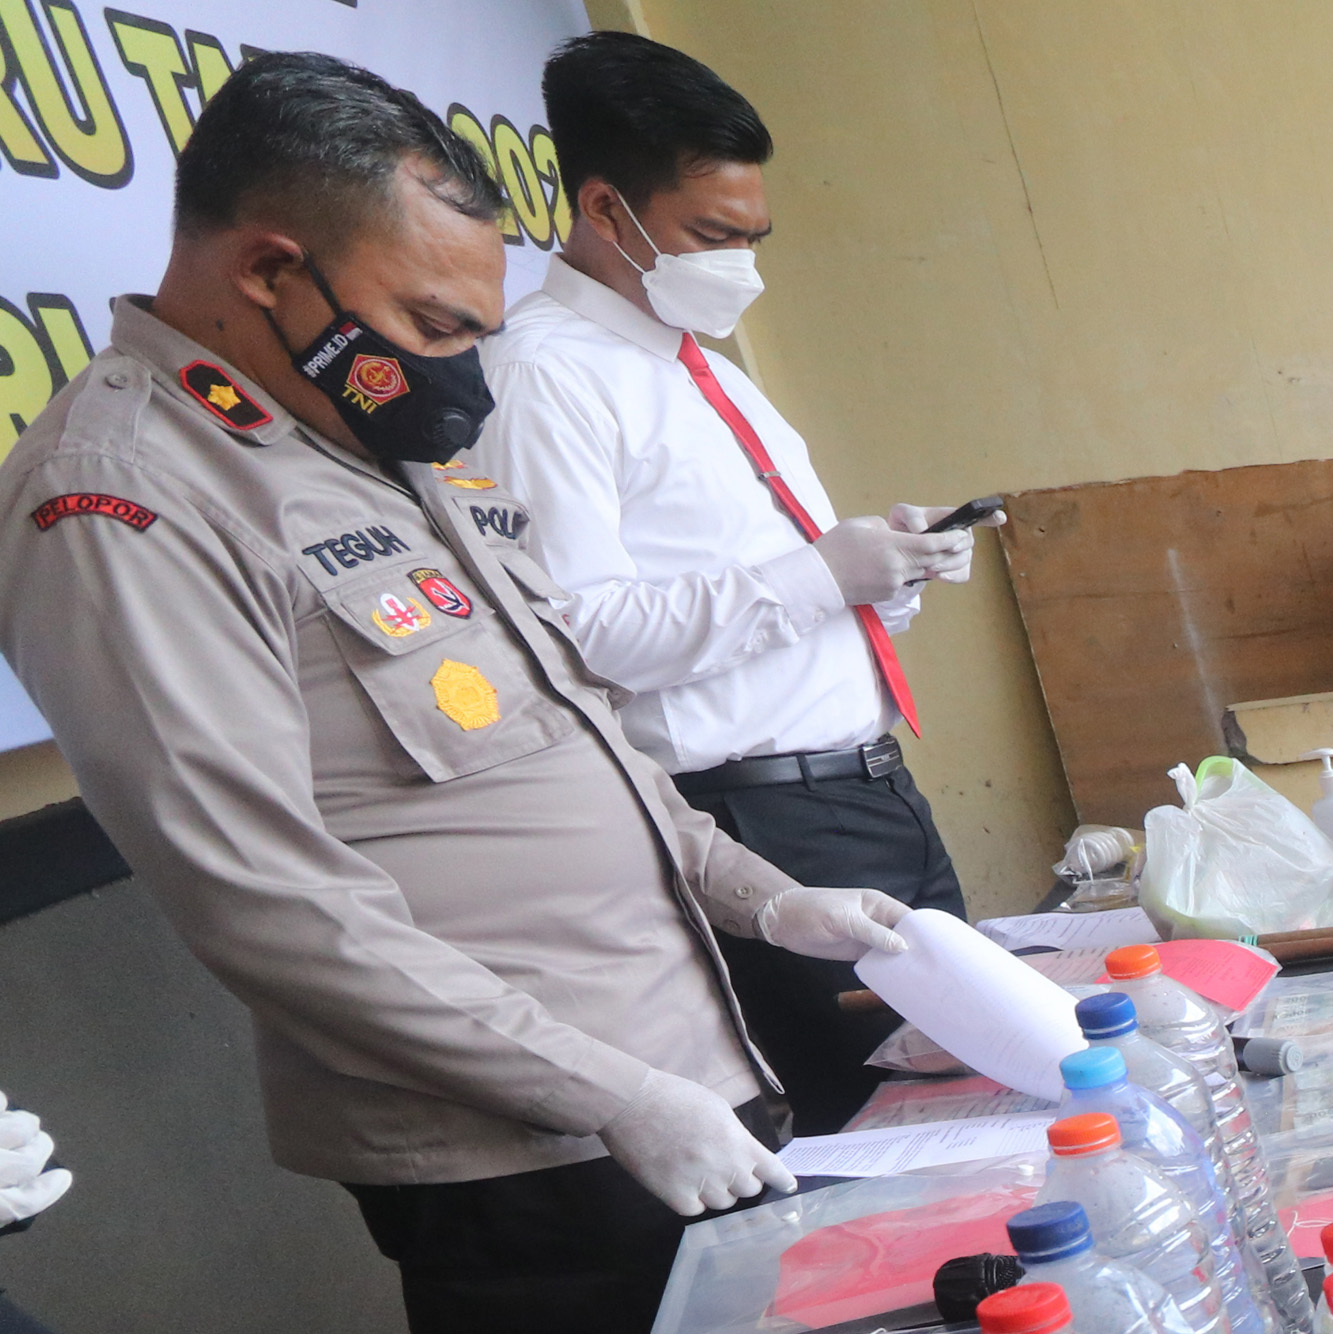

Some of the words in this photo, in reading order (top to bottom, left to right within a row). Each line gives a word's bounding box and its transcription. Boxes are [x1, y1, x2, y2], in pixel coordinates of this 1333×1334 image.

[341, 384, 378, 415] TNI
[38, 495, 152, 530] PELOPOR
[469, 505, 518, 541] POL
[302, 525, 411, 576] TEGUH
